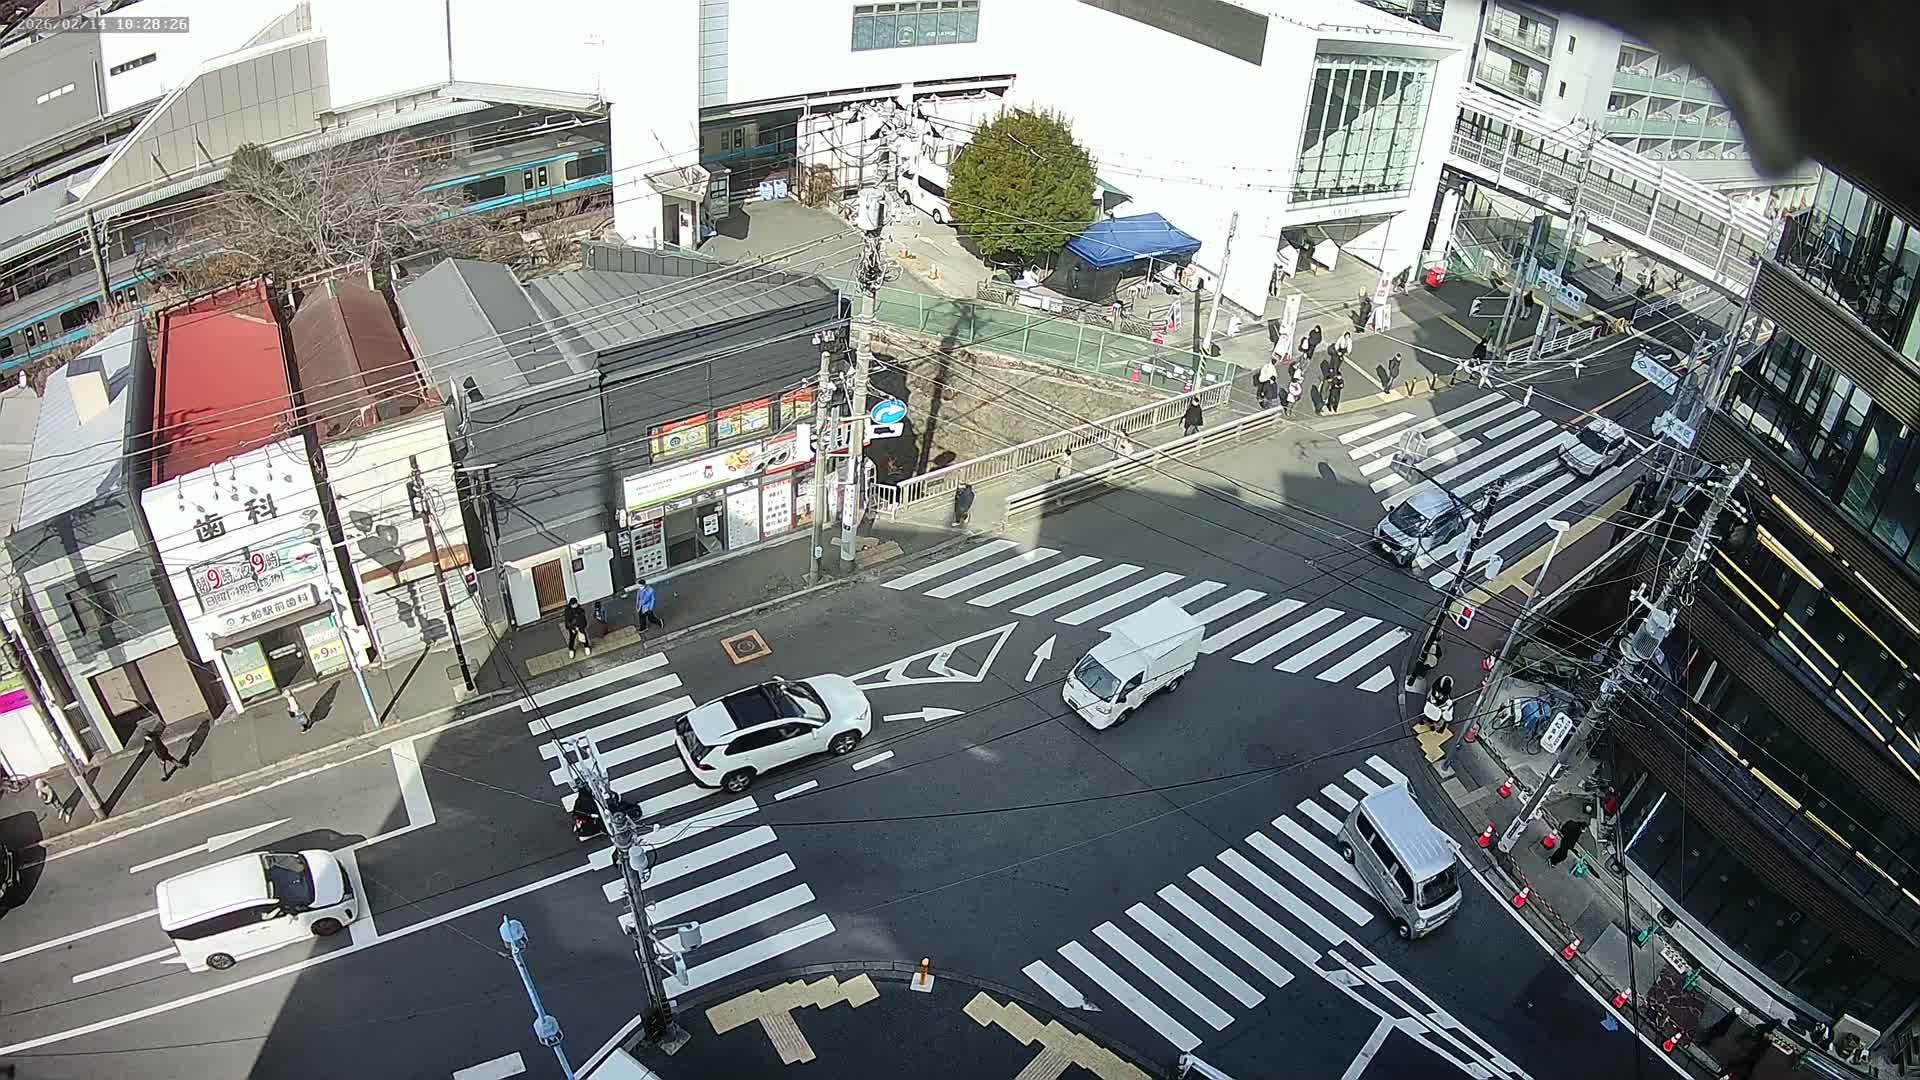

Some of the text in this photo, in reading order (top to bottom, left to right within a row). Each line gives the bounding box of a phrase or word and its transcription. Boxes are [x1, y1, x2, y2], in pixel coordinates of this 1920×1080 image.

[193, 494, 278, 543] 歯科
[240, 592, 308, 624] 大船駅前歯科
